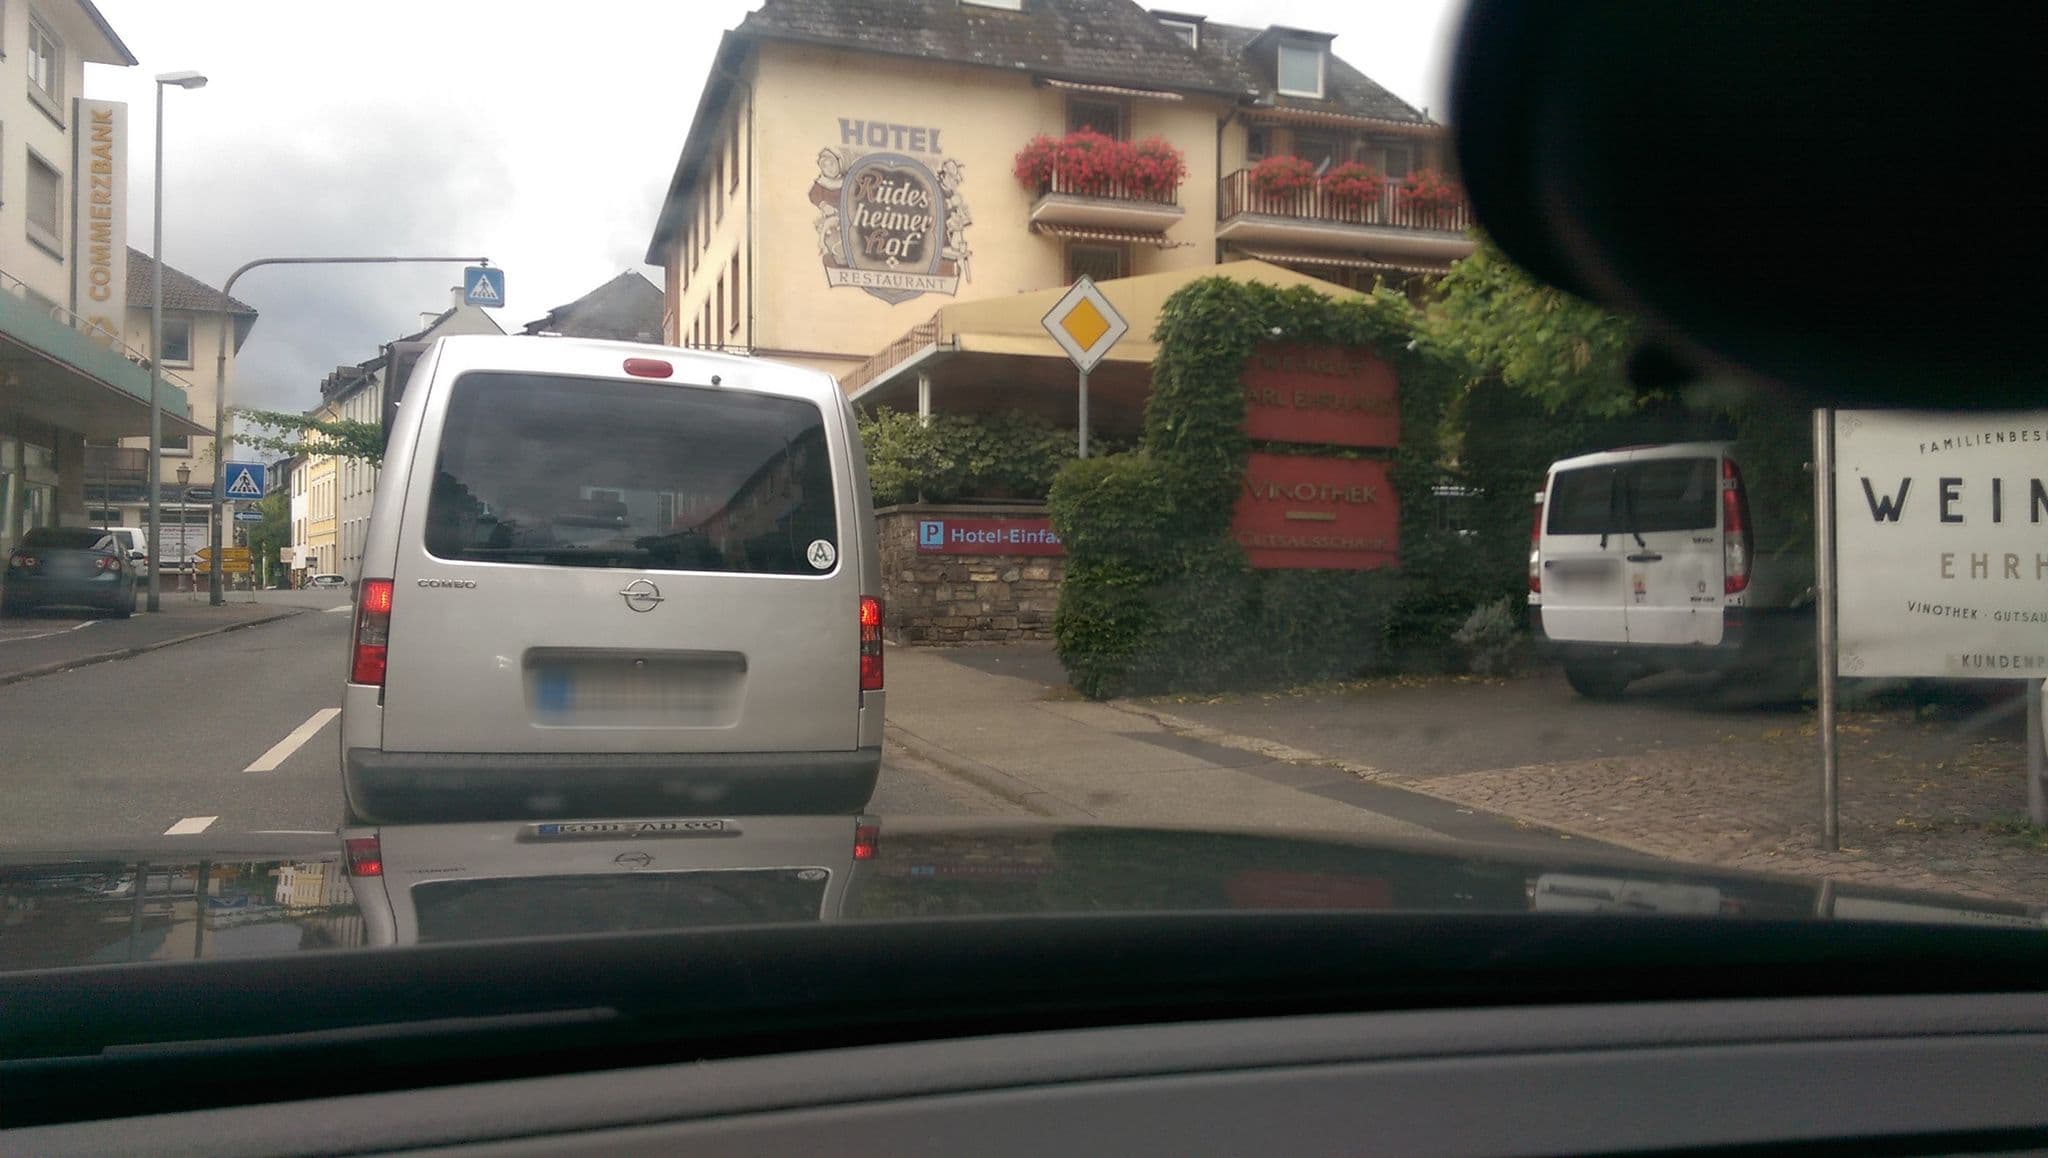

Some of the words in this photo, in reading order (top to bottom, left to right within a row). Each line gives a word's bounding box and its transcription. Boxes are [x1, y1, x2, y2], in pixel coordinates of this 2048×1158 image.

[838, 117, 942, 154] HOTEL
[853, 171, 929, 208] Rüdes
[89, 108, 113, 302] COMMERZBANK
[853, 203, 934, 233] heimer
[839, 271, 946, 289] RESTAURANT
[1249, 480, 1377, 503] VINOTHEK
[1860, 476, 2048, 523] WEIN
[417, 578, 477, 589] COMBO
[1907, 600, 1979, 620] VINOTHEK
